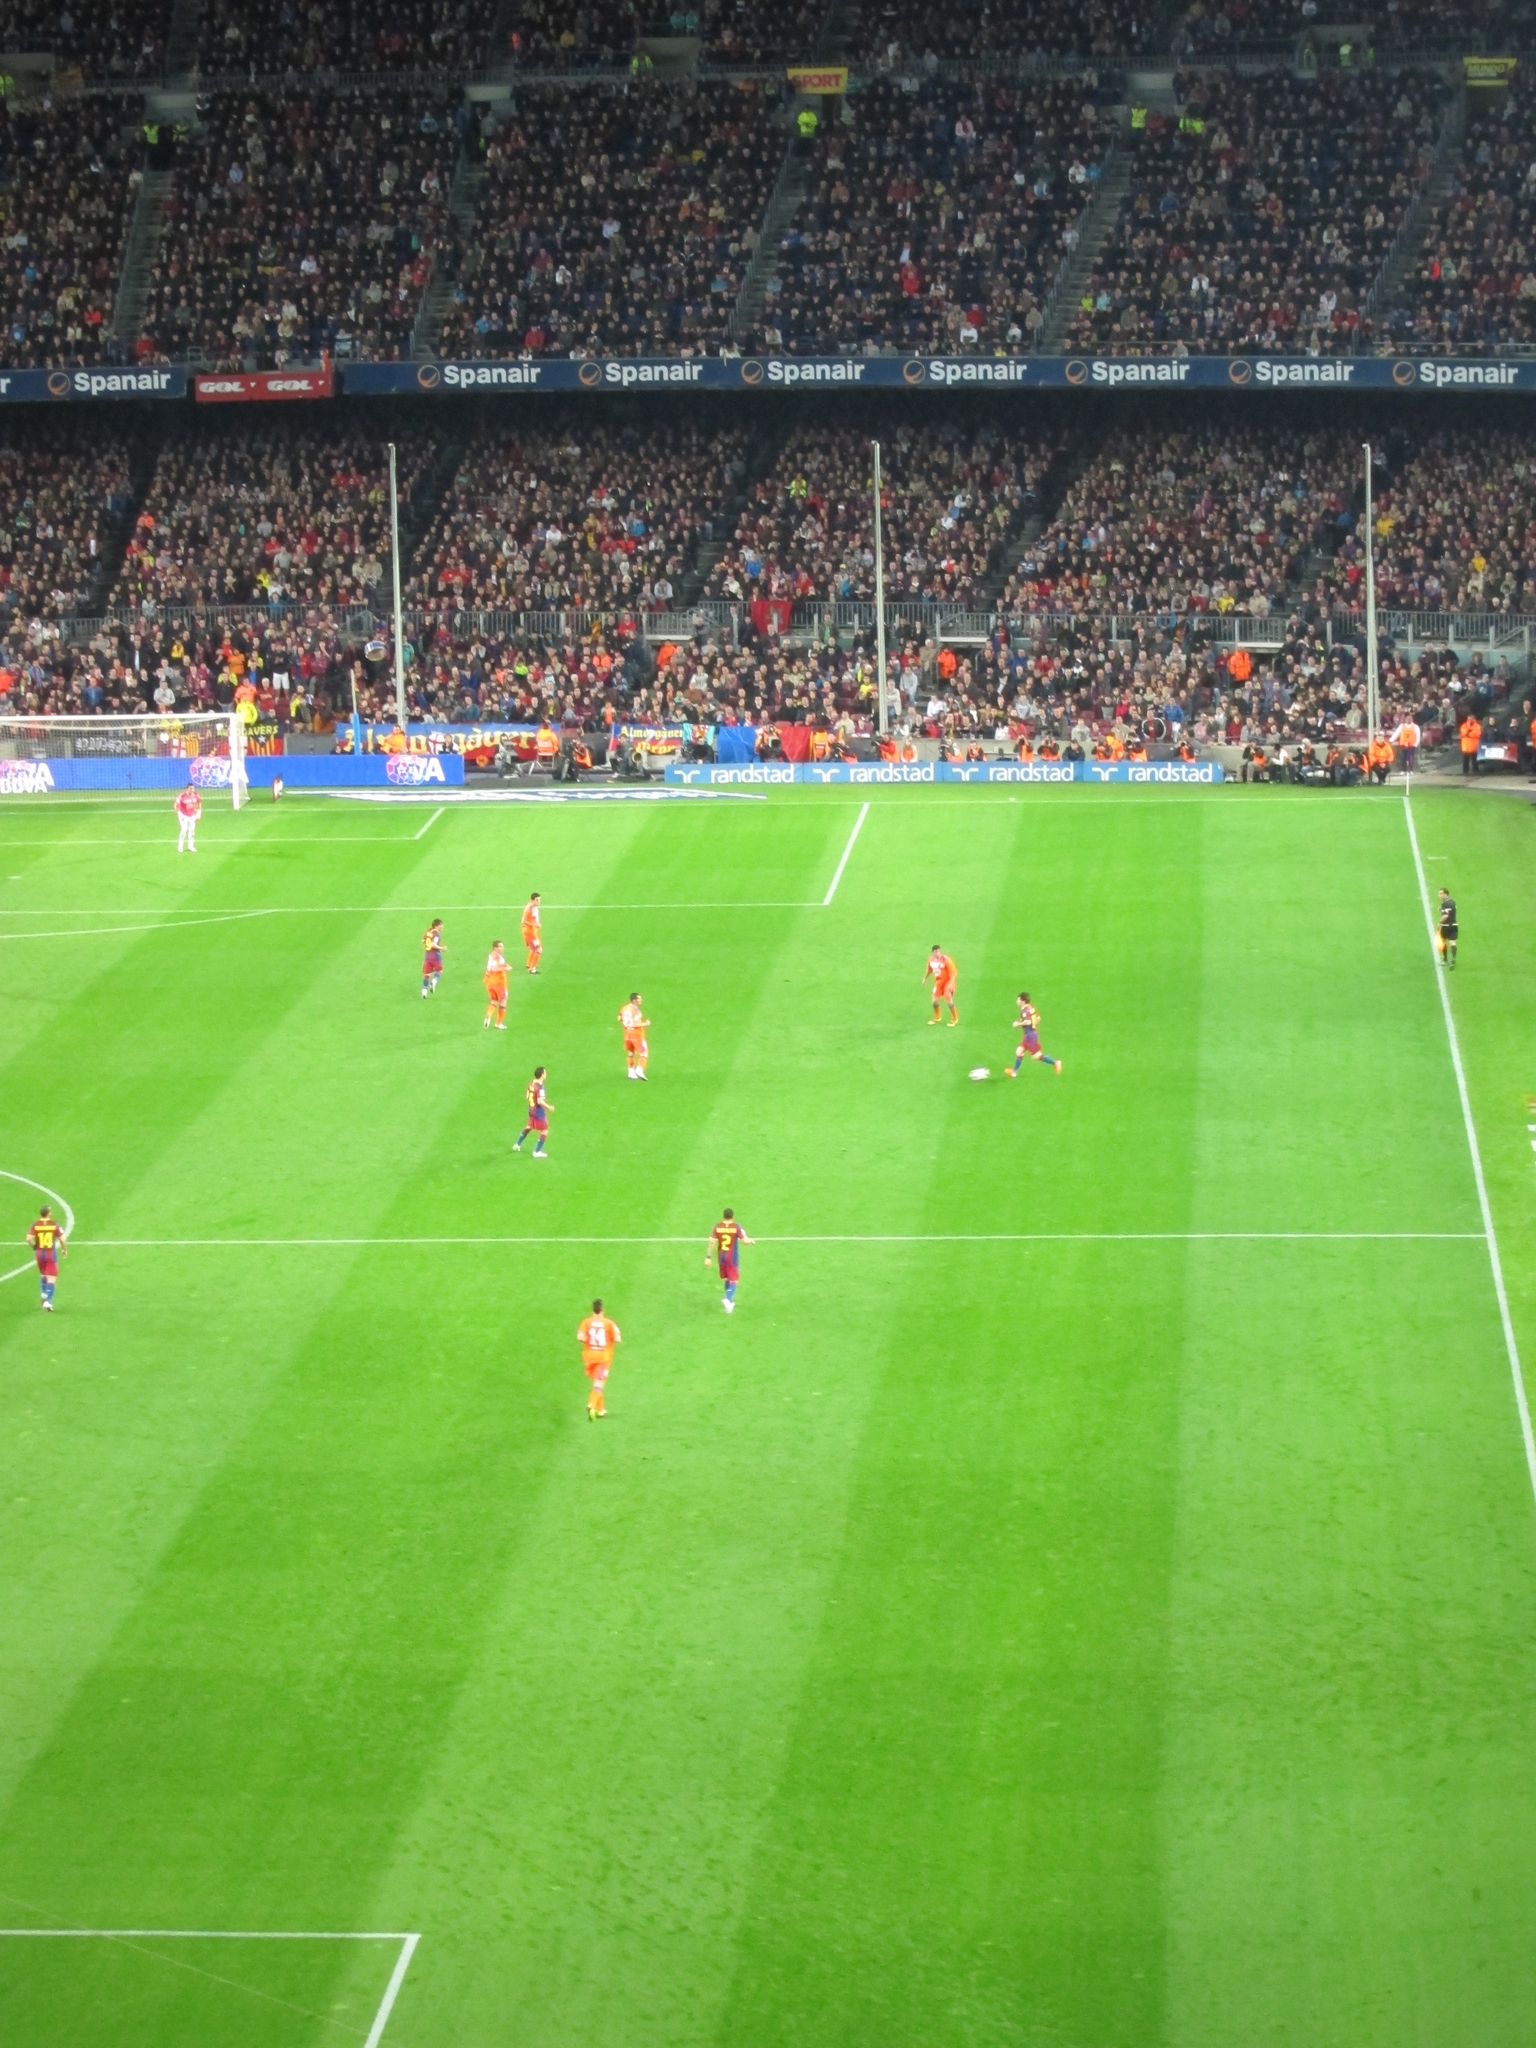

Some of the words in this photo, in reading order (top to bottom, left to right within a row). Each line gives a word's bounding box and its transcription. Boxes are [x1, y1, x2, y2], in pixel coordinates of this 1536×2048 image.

[791, 73, 842, 88] SPORT
[75, 370, 171, 396] Spanair
[444, 363, 541, 388] Spanair
[605, 361, 703, 386] Spanair
[767, 360, 865, 385] Spanair
[929, 360, 1027, 385] Spanair
[1092, 360, 1190, 385] Spanair
[1255, 361, 1354, 386] Spanair
[1419, 362, 1519, 387] Spanair
[711, 763, 794, 784] randstad
[849, 763, 934, 783] randstad
[989, 762, 1074, 782] randstad
[1128, 762, 1213, 782] randstad
[721, 1234, 732, 1251] 2
